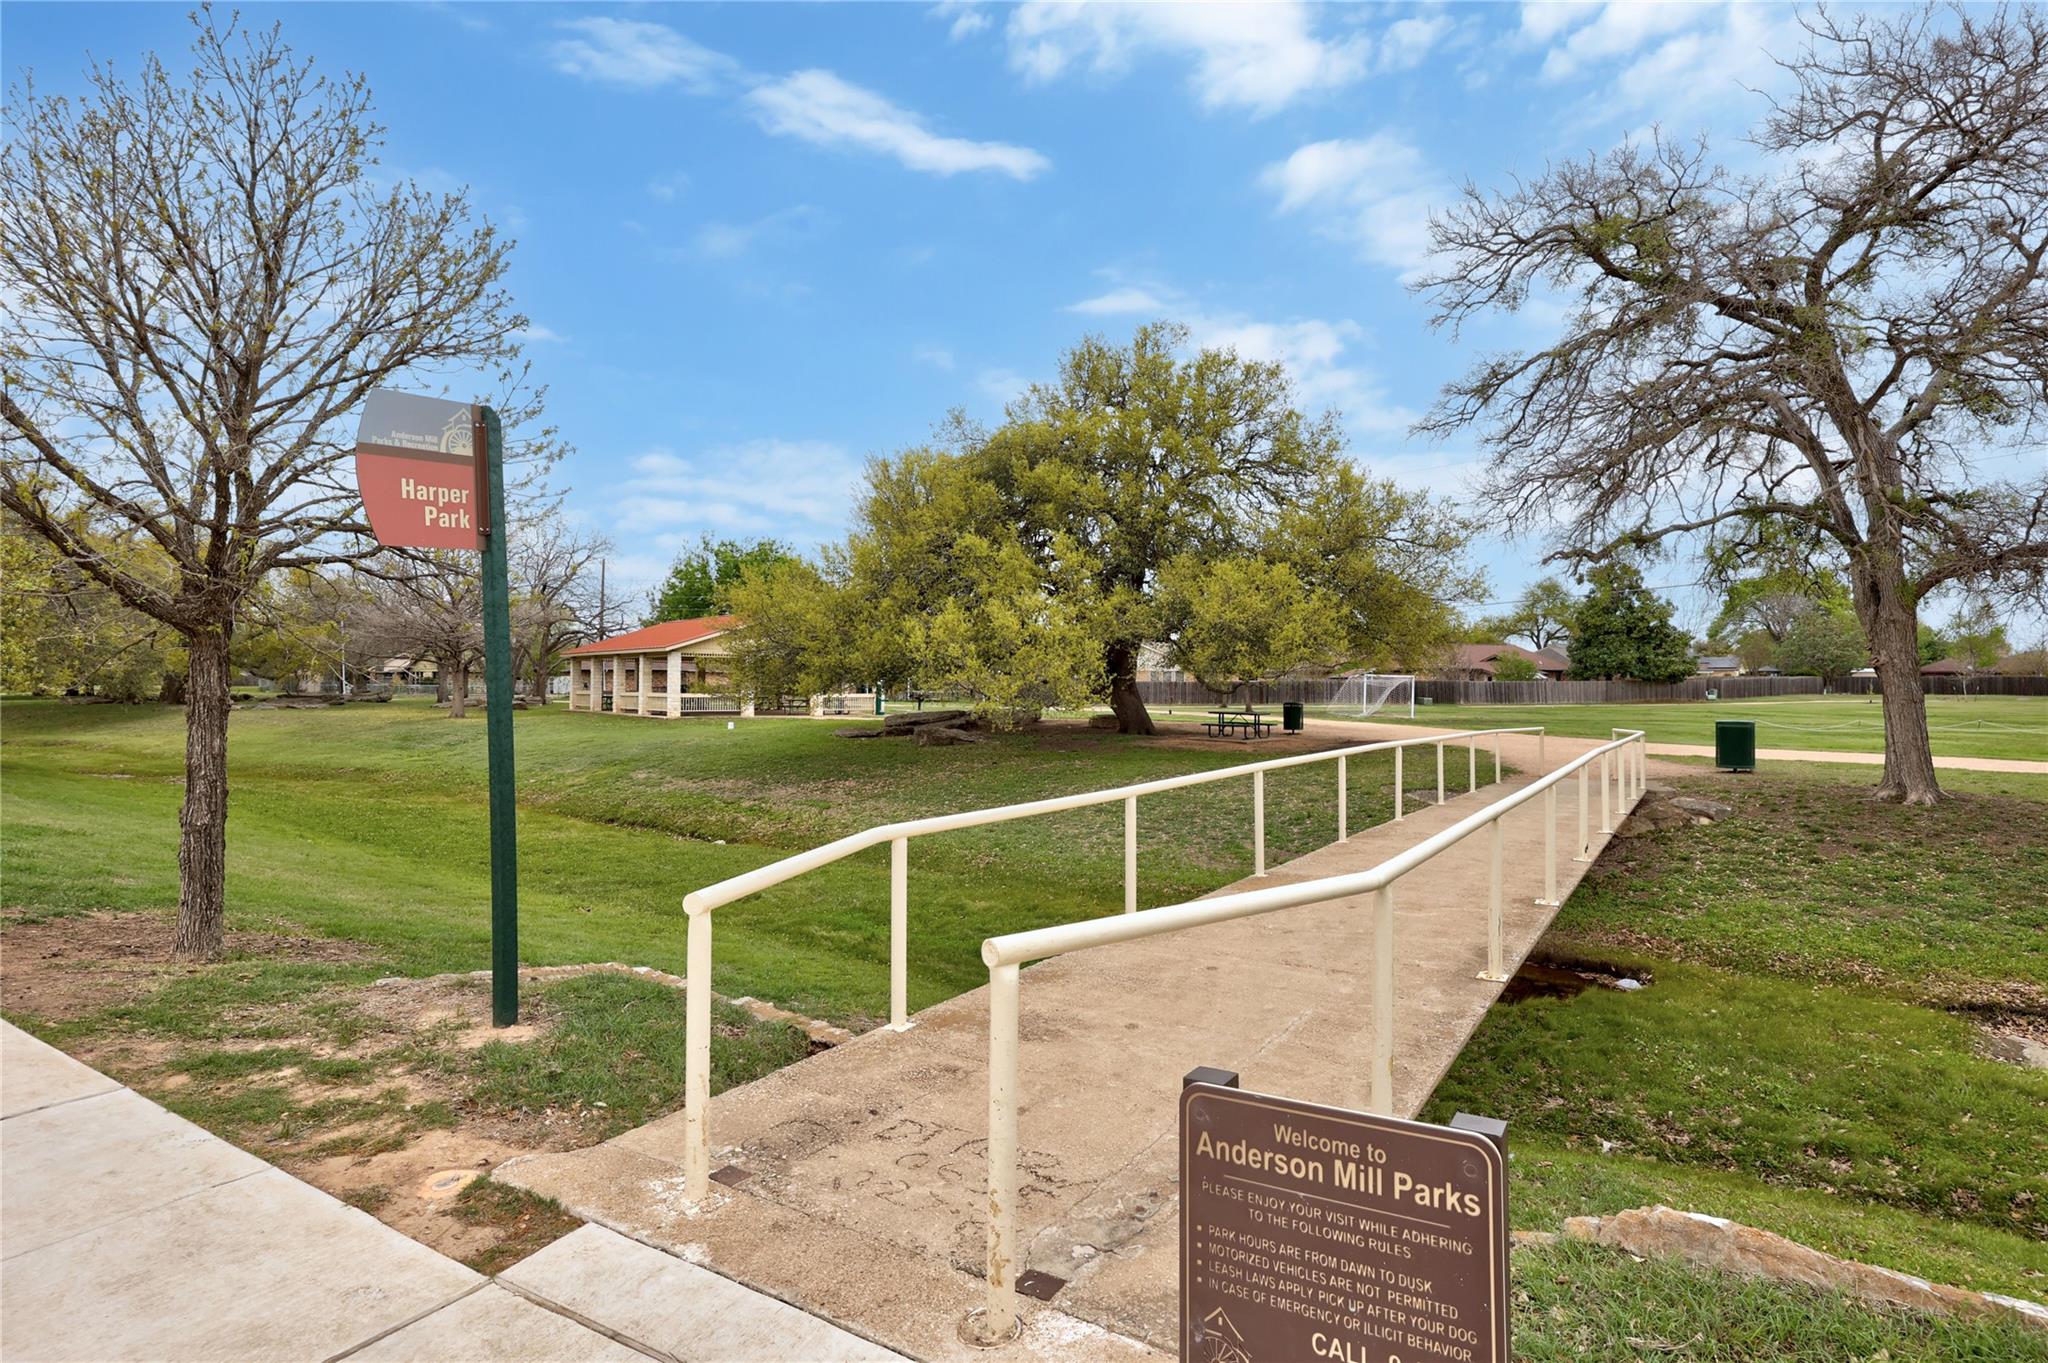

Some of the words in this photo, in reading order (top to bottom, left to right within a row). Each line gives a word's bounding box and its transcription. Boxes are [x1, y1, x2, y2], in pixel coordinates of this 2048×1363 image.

[401, 478, 470, 507] Harper
[424, 506, 471, 529] Park
[1196, 1130, 1323, 1183] Anderson
[1333, 1159, 1382, 1196] Mill
[1394, 1171, 1481, 1217] Parks
[1273, 1123, 1361, 1159] Welcome
[1366, 1143, 1387, 1164] to
[1202, 1181, 1245, 1201] PLEASE
[1248, 1192, 1285, 1210] ENJOY
[1288, 1202, 1322, 1220] YOUR
[1325, 1210, 1355, 1228] VISIT
[1359, 1219, 1398, 1238] WHILE
[1402, 1228, 1473, 1255] ADHERING
[1249, 1209, 1263, 1223] TO
[1267, 1213, 1289, 1230] THE
[1292, 1219, 1365, 1248] FOLLOWING
[1368, 1238, 1412, 1259] RULES
[1208, 1224, 1236, 1242] PARK
[1239, 1233, 1276, 1254] HOURS
[1279, 1244, 1301, 1260] ARE
[1305, 1250, 1337, 1269] FROM
[1340, 1259, 1375, 1279] DAWN
[1379, 1269, 1395, 1284] TO
[1398, 1274, 1433, 1294] DUSK
[1208, 1242, 1270, 1270] MOTORIZED
[1273, 1260, 1327, 1285] VEHICLES
[1329, 1276, 1353, 1292] ARE
[1356, 1282, 1382, 1299] NOT
[1387, 1290, 1458, 1320] PERMITTED
[1208, 1260, 1243, 1281] LEASH
[1246, 1270, 1276, 1290] LAWS
[1278, 1280, 1314, 1299] APPLY
[1318, 1290, 1345, 1309] PICK
[1348, 1299, 1364, 1314] UP
[1367, 1303, 1407, 1326] AFTER
[1410, 1314, 1445, 1336] YOUR
[1448, 1325, 1478, 1345] DOG
[1208, 1277, 1219, 1291] IN
[1221, 1281, 1250, 1300] CASE
[1252, 1290, 1267, 1304] OF
[1270, 1295, 1341, 1326] EMERGENCY
[1343, 1315, 1361, 1332] OR
[1363, 1321, 1404, 1344] ILLICIT
[1407, 1333, 1473, 1363] BEHAVIOR
